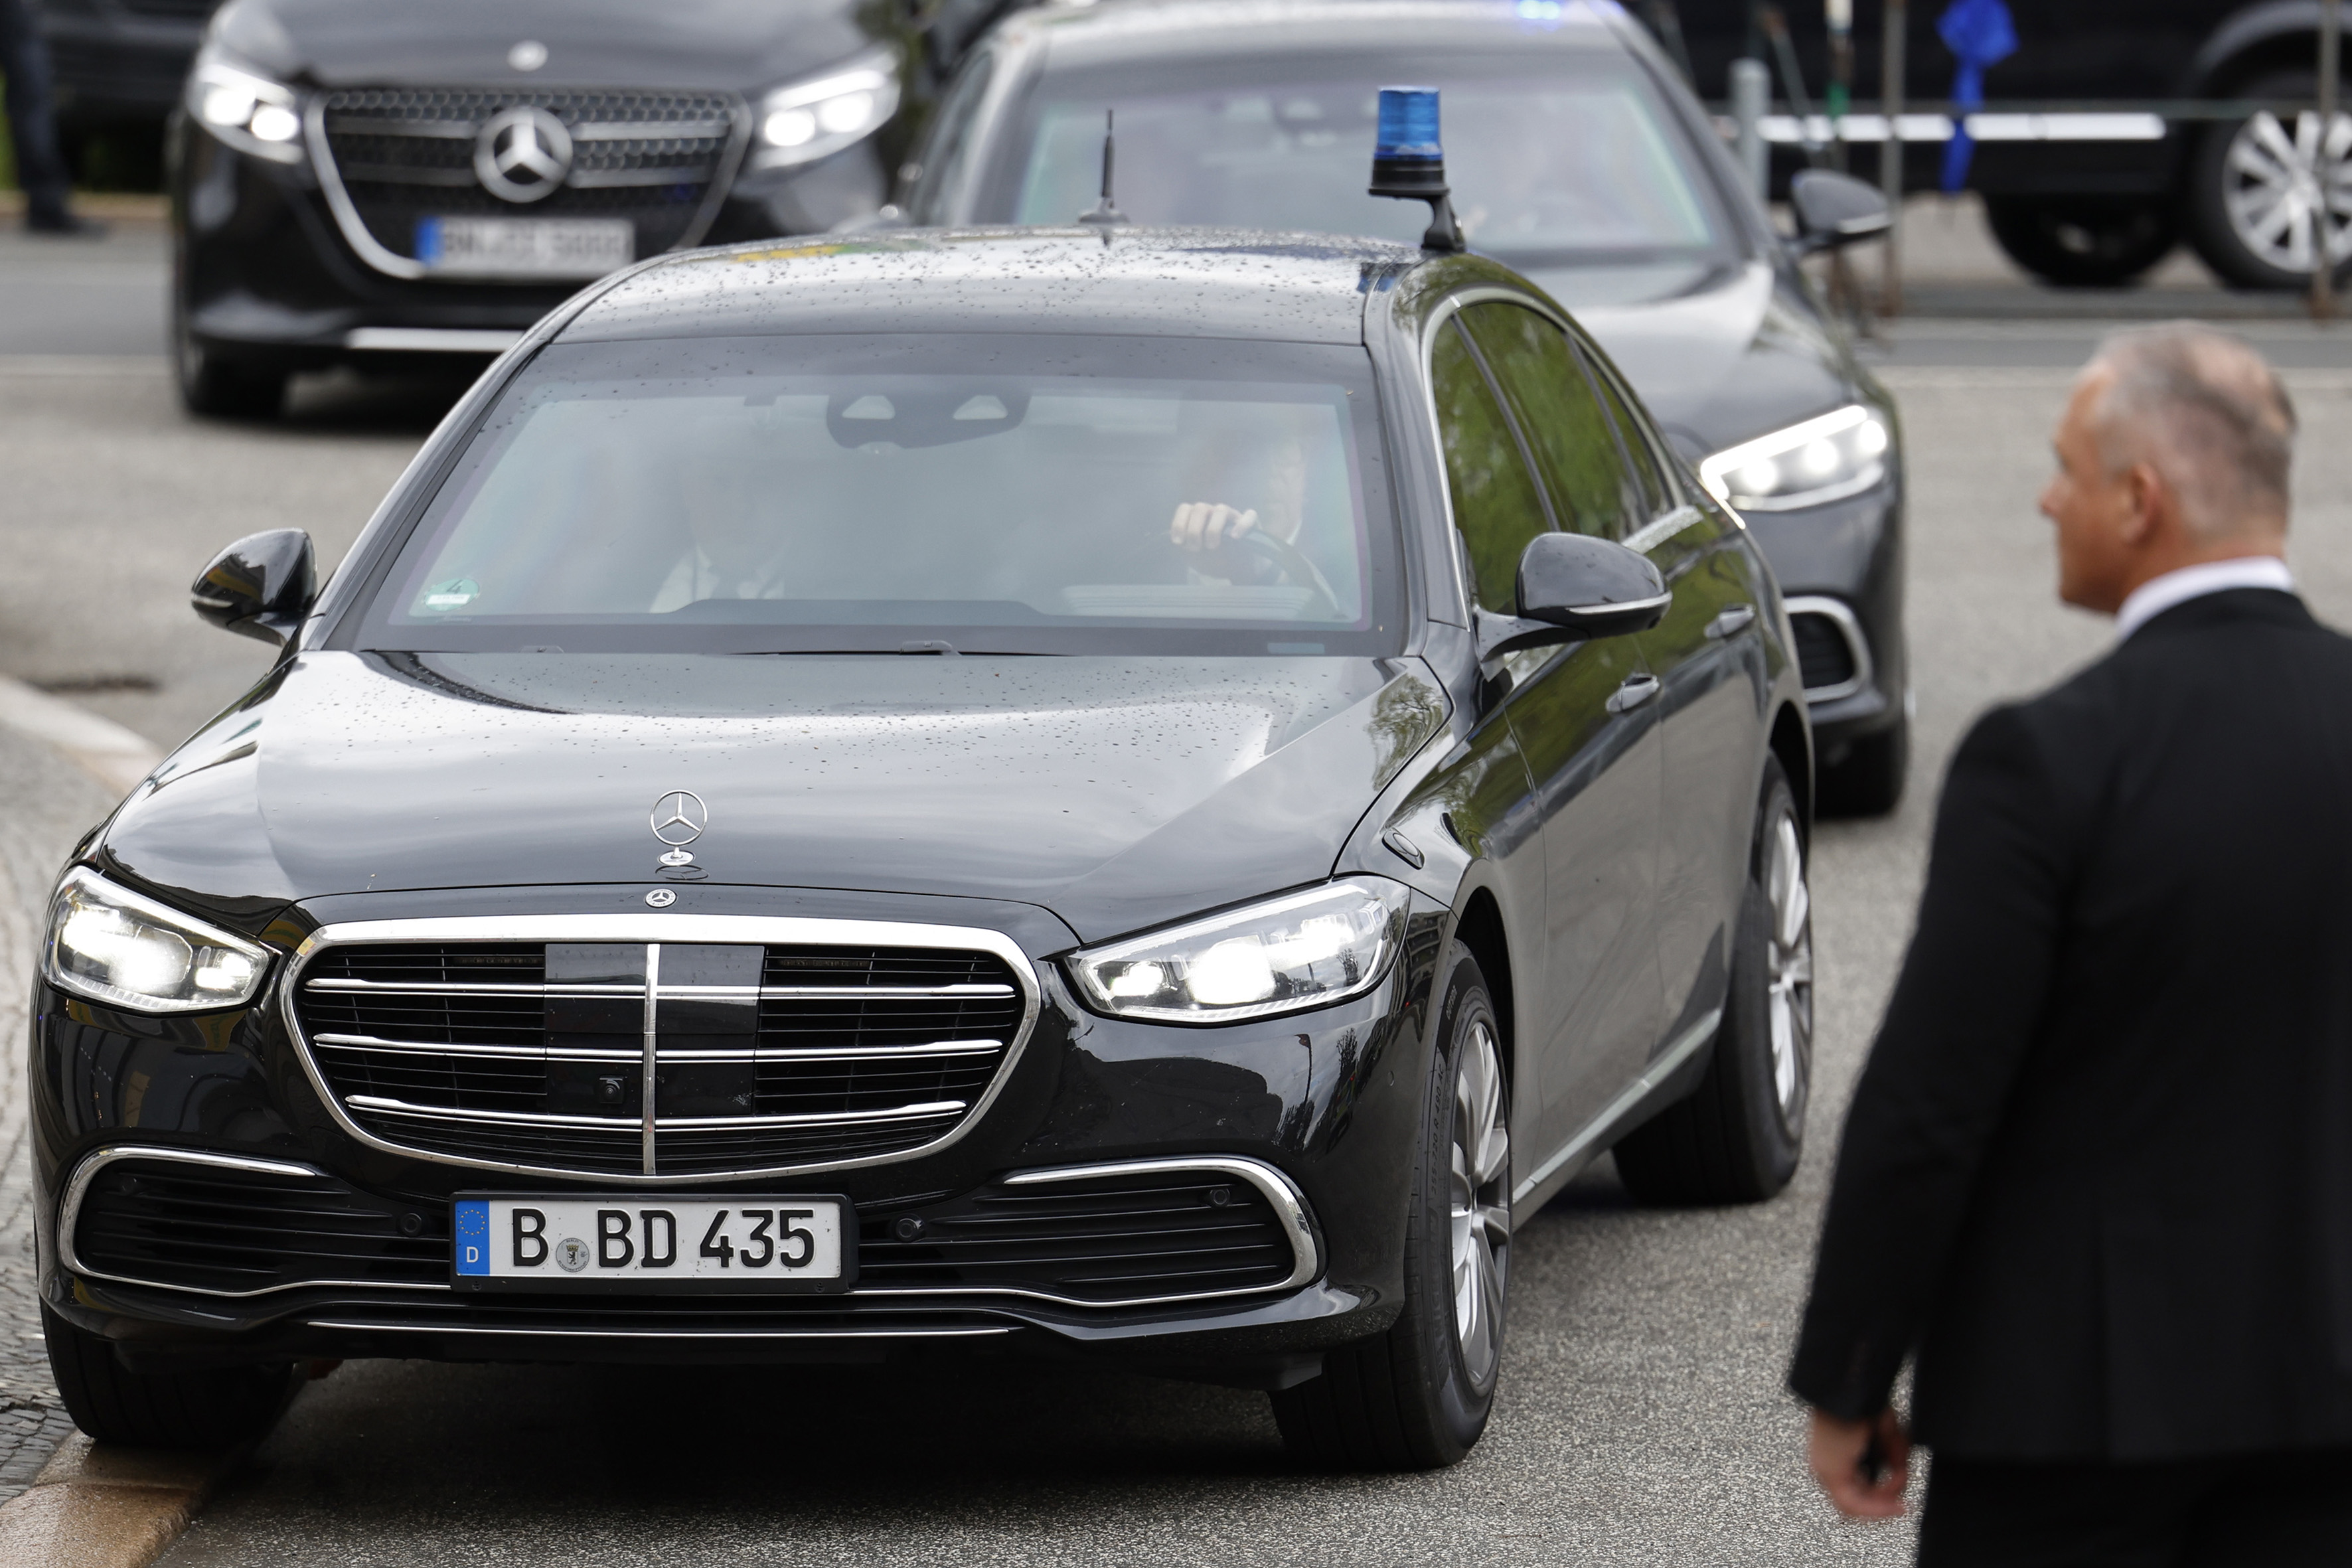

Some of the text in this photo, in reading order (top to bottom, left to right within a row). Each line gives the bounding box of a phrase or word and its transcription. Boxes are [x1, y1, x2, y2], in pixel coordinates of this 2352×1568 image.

[447, 580, 463, 594] 4
[512, 1209, 814, 1267] B BD 435
[466, 1247, 478, 1262] D
